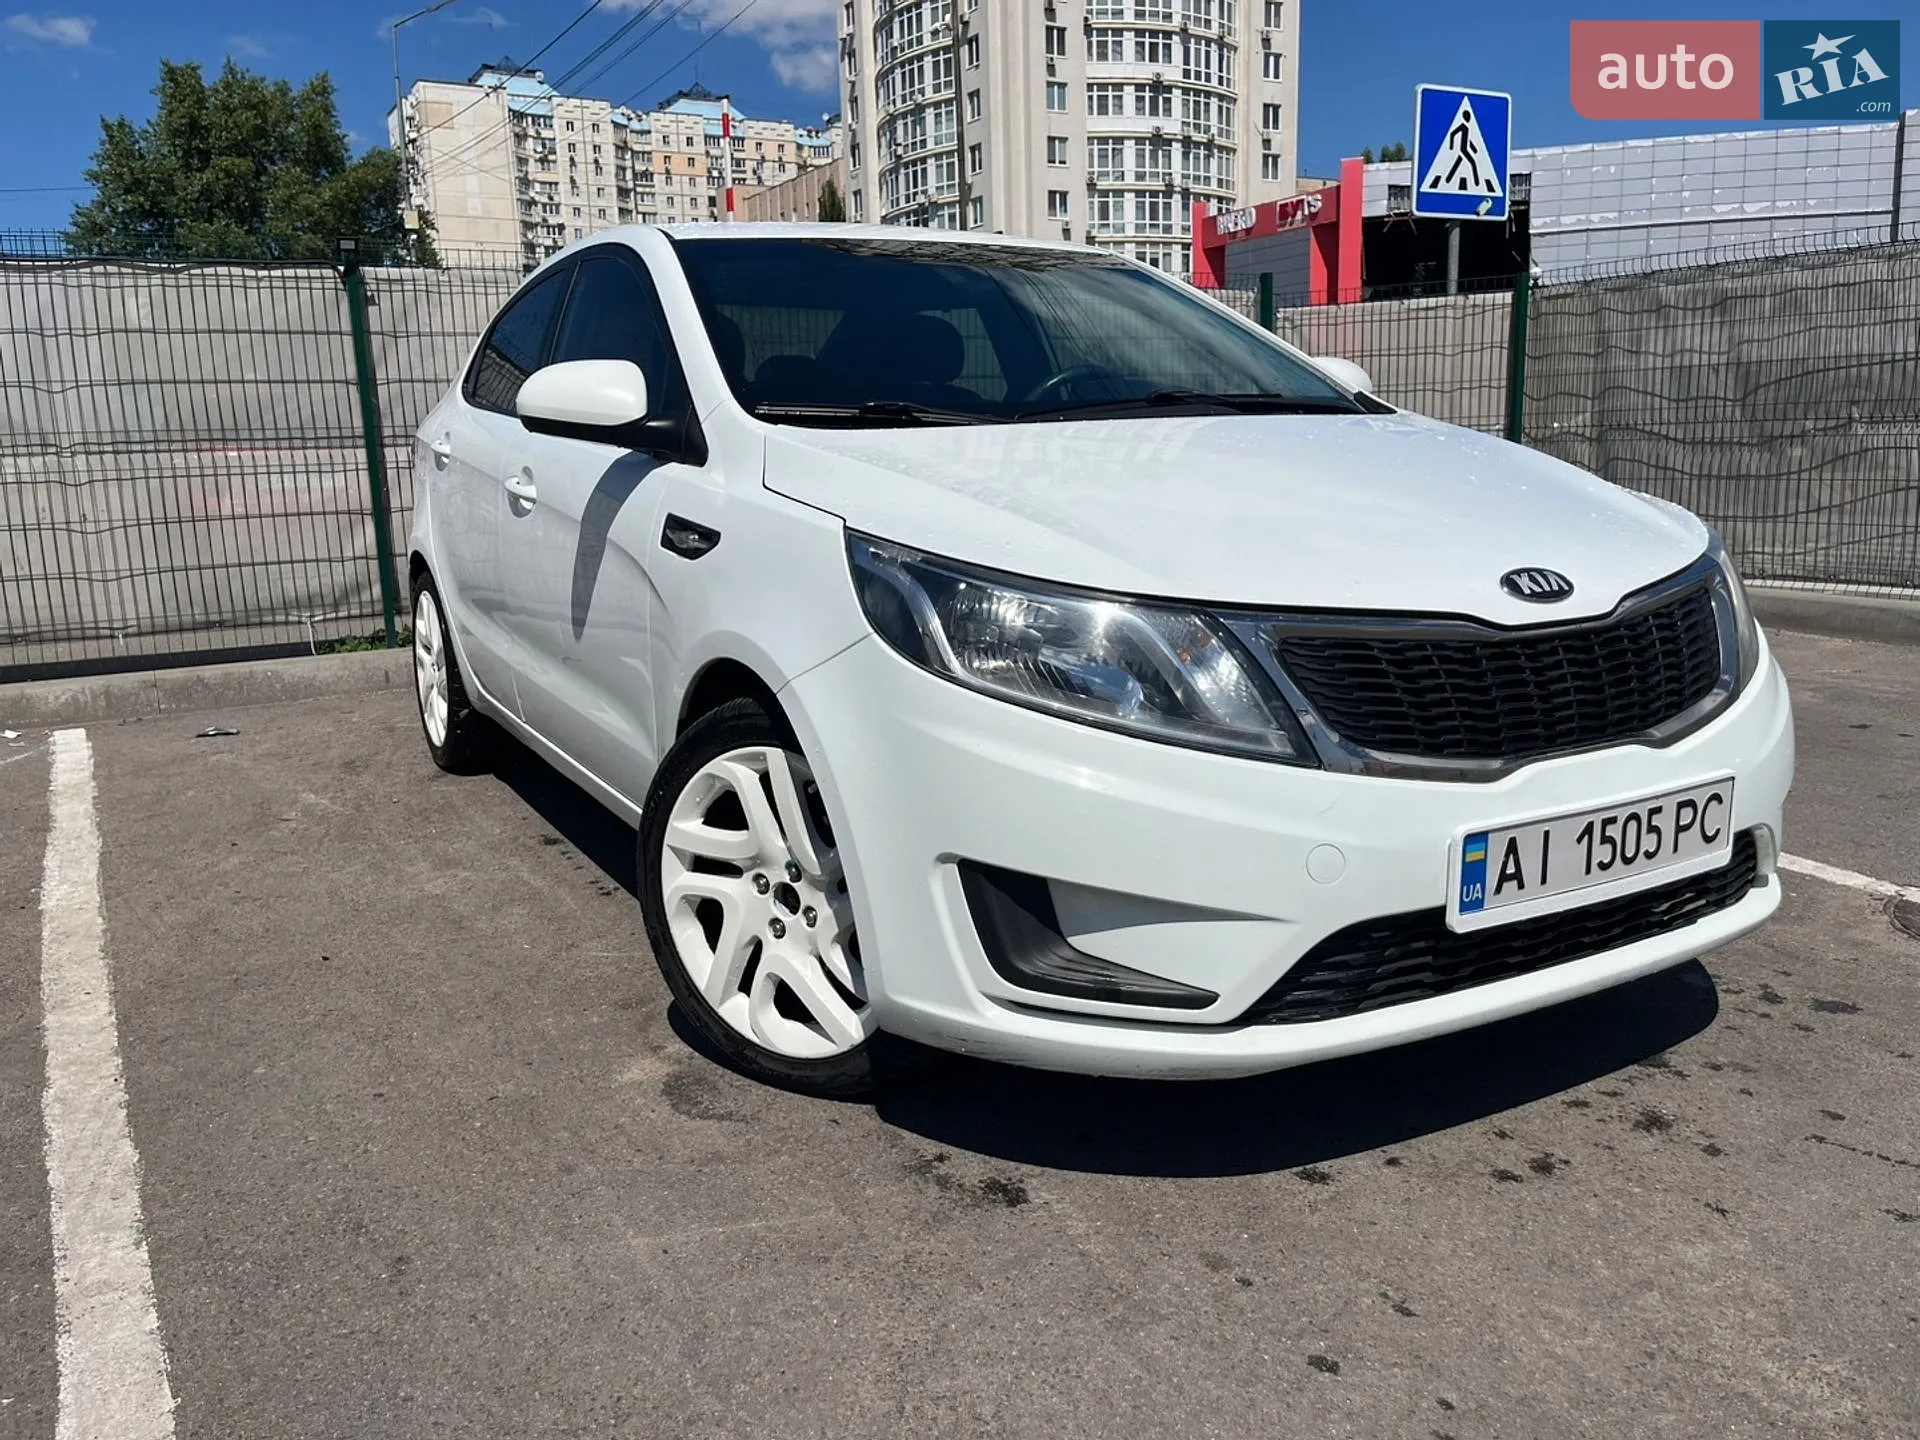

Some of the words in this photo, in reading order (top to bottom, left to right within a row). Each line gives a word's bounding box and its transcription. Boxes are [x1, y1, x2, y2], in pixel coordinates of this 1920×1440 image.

[1509, 570, 1570, 595] KIA
[1493, 830, 1550, 896] AI
[1575, 805, 1664, 876] 1505
[1672, 793, 1724, 854] PC
[1461, 883, 1482, 903] UA
